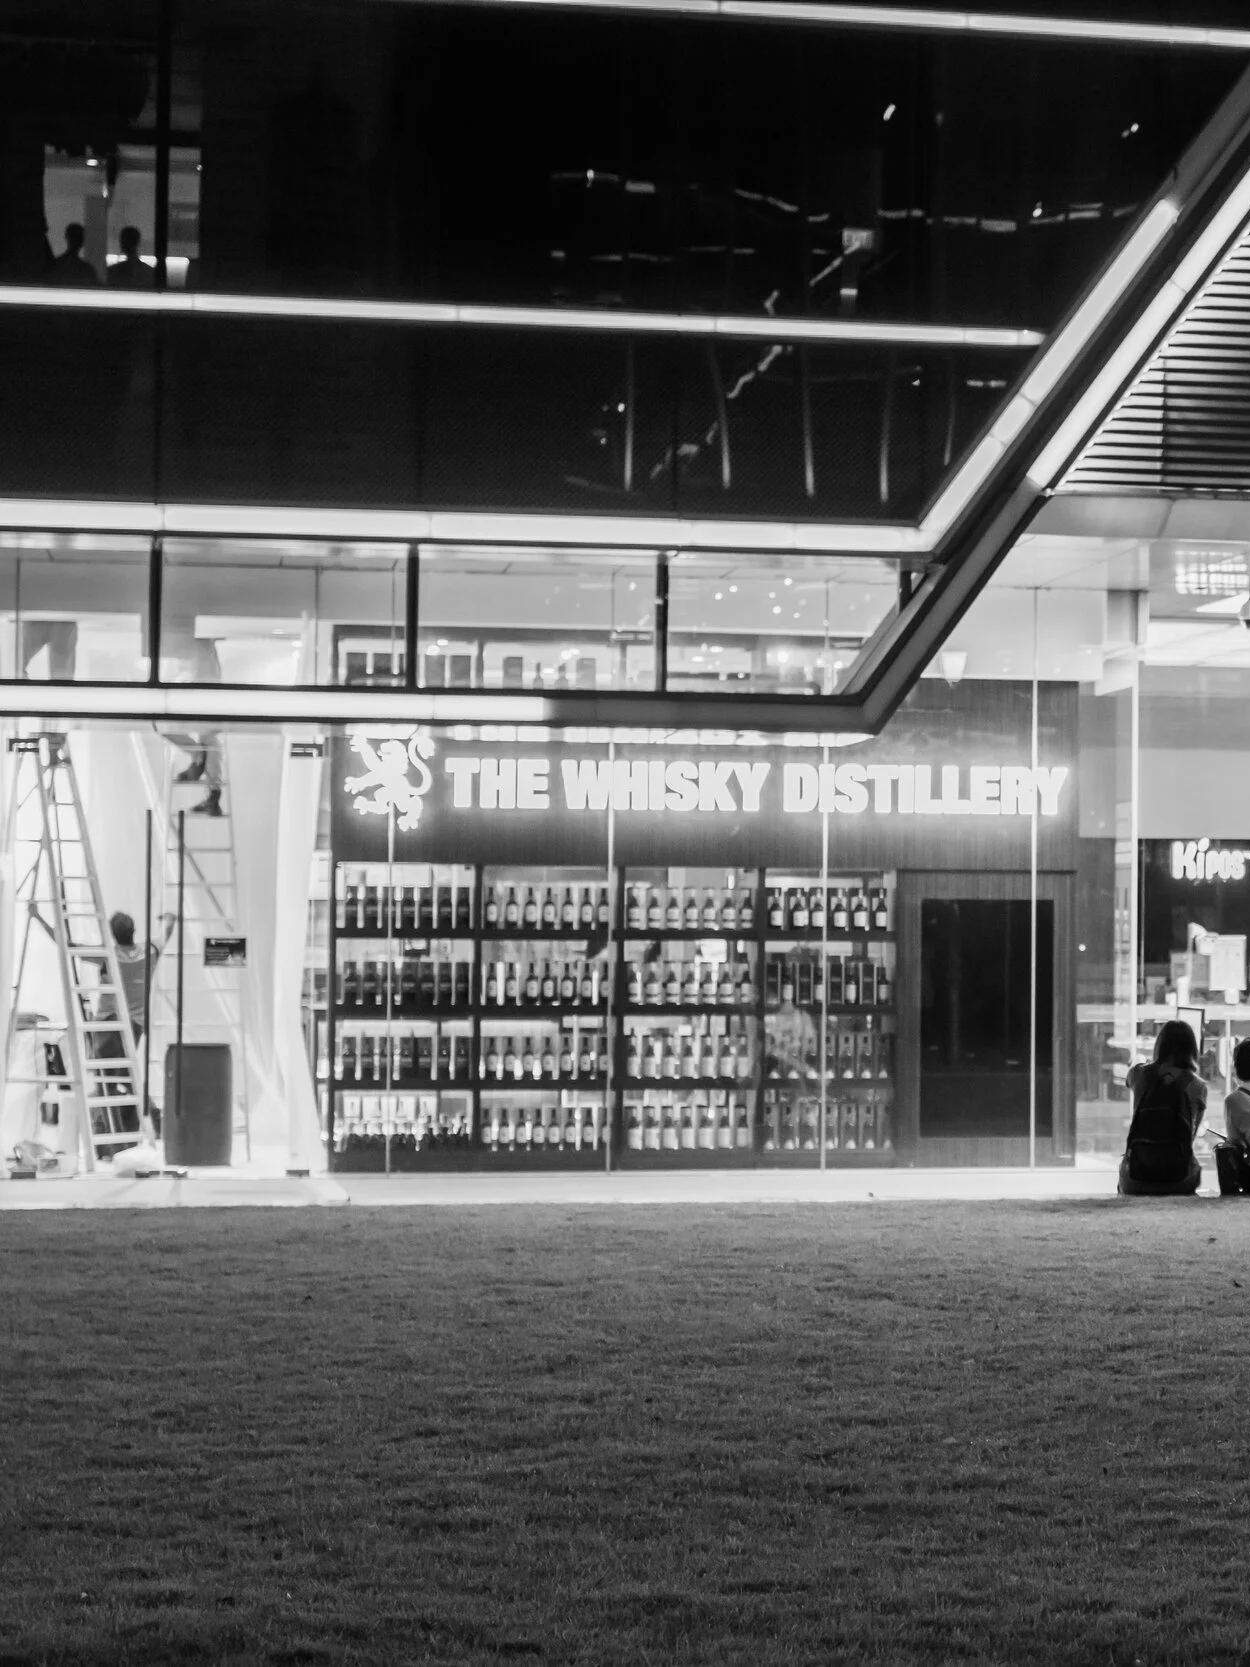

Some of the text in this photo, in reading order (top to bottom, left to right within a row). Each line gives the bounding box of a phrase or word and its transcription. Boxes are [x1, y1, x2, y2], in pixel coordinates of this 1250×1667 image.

[445, 757, 1069, 817] THE WHISKY DISTILLERY
